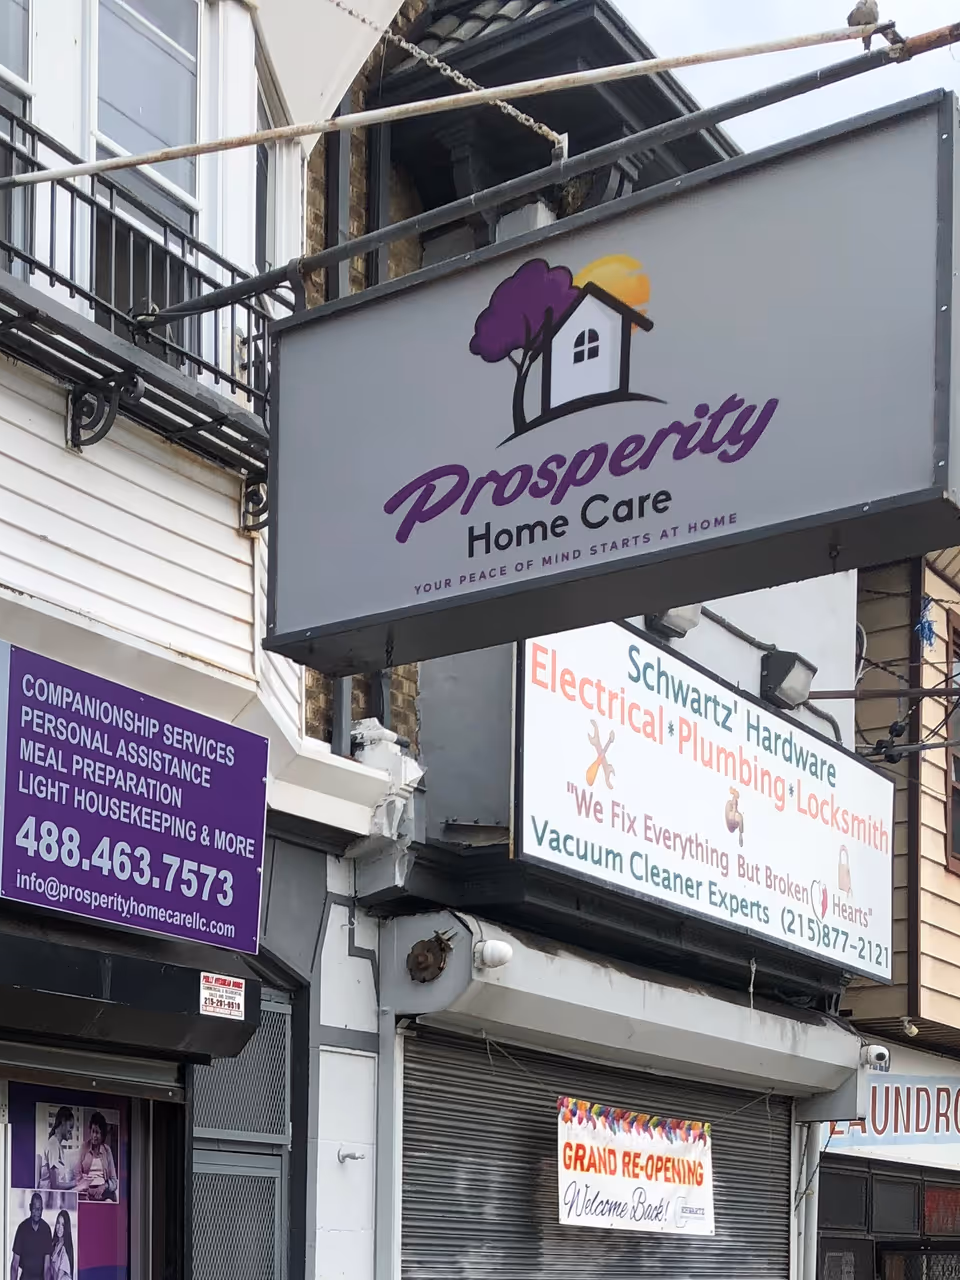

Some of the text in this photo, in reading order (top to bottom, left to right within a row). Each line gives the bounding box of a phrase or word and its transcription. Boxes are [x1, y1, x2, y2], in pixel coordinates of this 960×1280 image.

[383, 393, 779, 544] Prosperity
[414, 512, 738, 596] YOUR PEACE OF MIND STARTS AT HOME
[468, 489, 672, 558] Home Care
[21, 705, 211, 788] PERSONAL ASSISTANCE
[22, 673, 235, 767] COMPANIONSHIP SERVICES
[531, 642, 889, 855] Electrical Plumbing Locksmith
[628, 644, 836, 788] Schwartz' Hardware
[18, 770, 256, 859] LIGHT HOUSEKEEPING & MORE
[19, 737, 182, 808] MEAL PREPARATION
[15, 815, 234, 907] 488.463.7573
[531, 815, 889, 969] Vacuum Cleaner Experts (215)877-2121
[611, 800, 638, 837] Fix
[644, 813, 729, 878] Everything
[737, 853, 761, 885] But
[765, 865, 809, 905] Broken
[16, 869, 235, 938] info@prosperityhomecarellc.com
[562, 1141, 704, 1187] GRAND RE-OPENING
[563, 1180, 671, 1222] Welcome Back!
